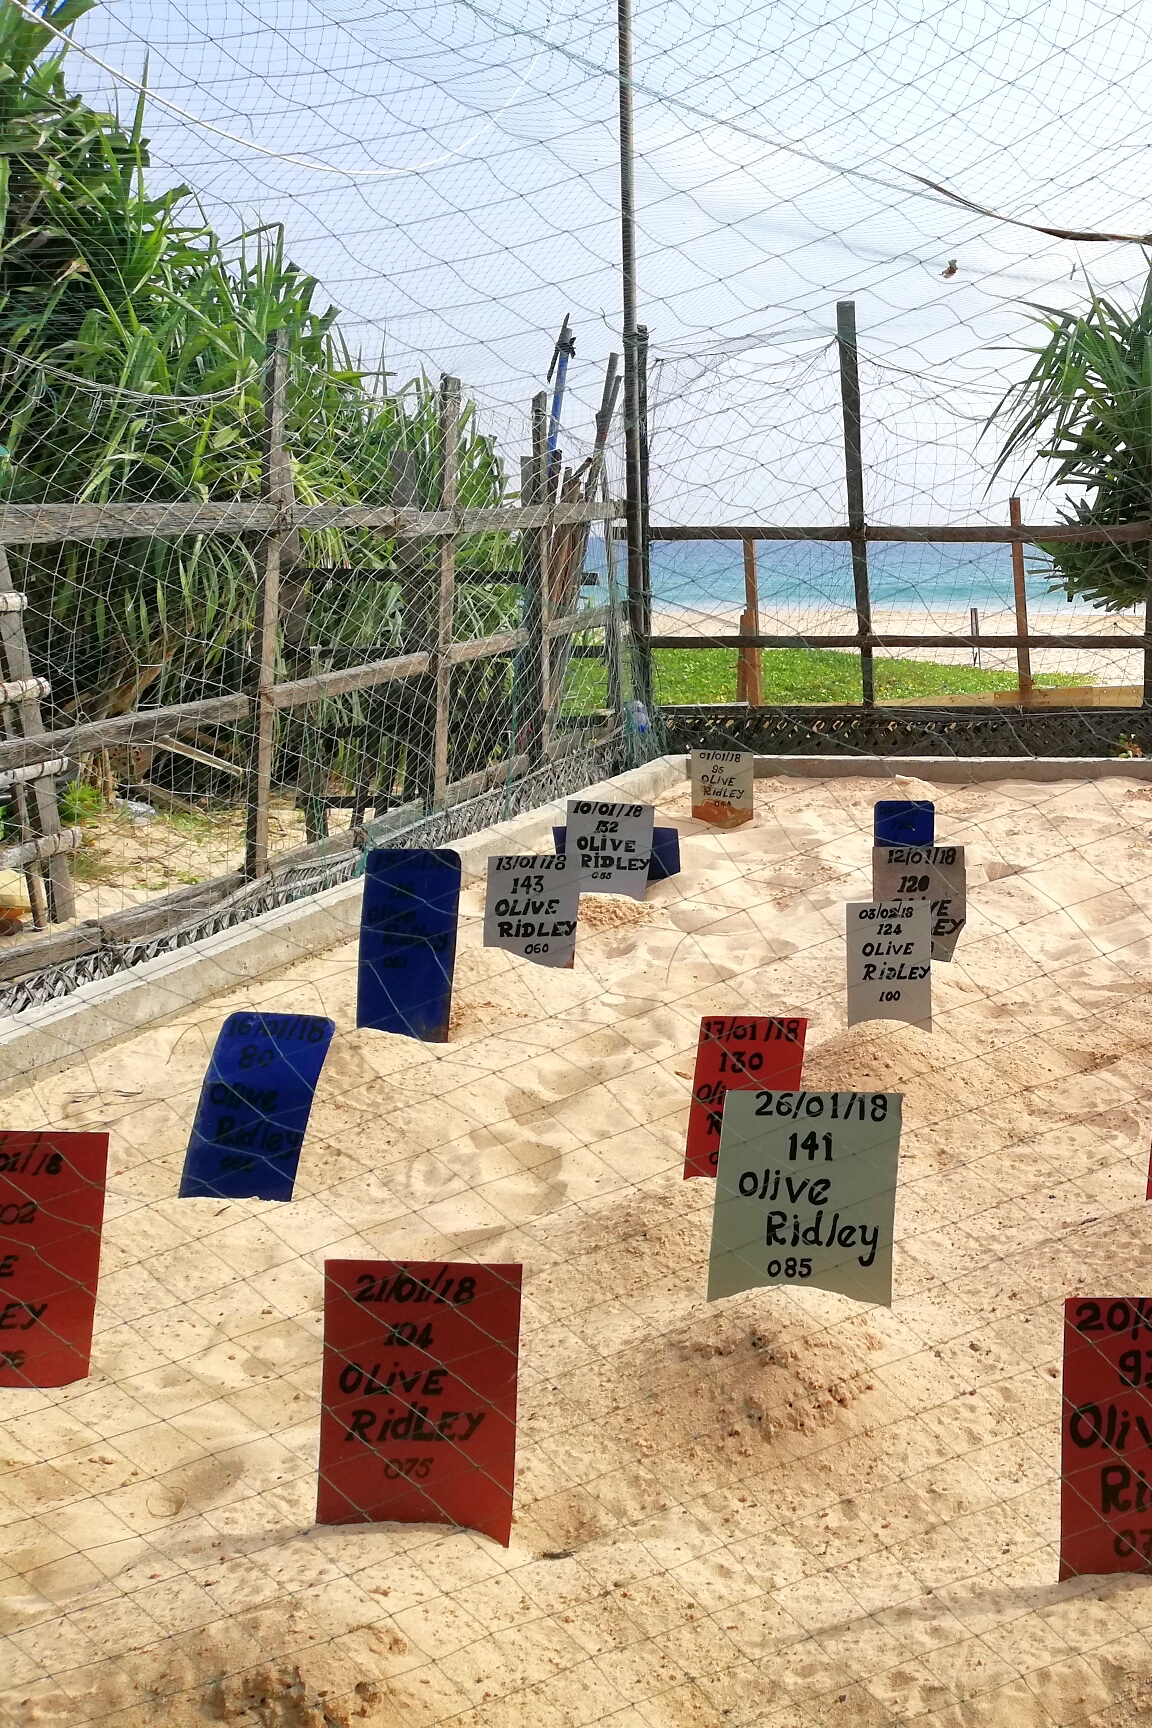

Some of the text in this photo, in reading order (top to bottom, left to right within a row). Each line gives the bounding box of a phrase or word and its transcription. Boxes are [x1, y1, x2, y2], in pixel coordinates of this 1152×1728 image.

[572, 800, 643, 818] 10/01/18
[511, 875, 544, 894] 143
[876, 923, 902, 935] 124
[524, 943, 549, 954] 060
[879, 990, 901, 1002] 100
[238, 1044, 275, 1070] 80
[718, 1051, 764, 1073] 130
[754, 1090, 889, 1122] 26/01/18
[788, 1131, 834, 1162] 141
[738, 1168, 832, 1206] Olive
[766, 1209, 880, 1268] Ridley
[767, 1257, 813, 1278] 085
[383, 1322, 434, 1348] 104
[383, 1457, 435, 1480] 075
